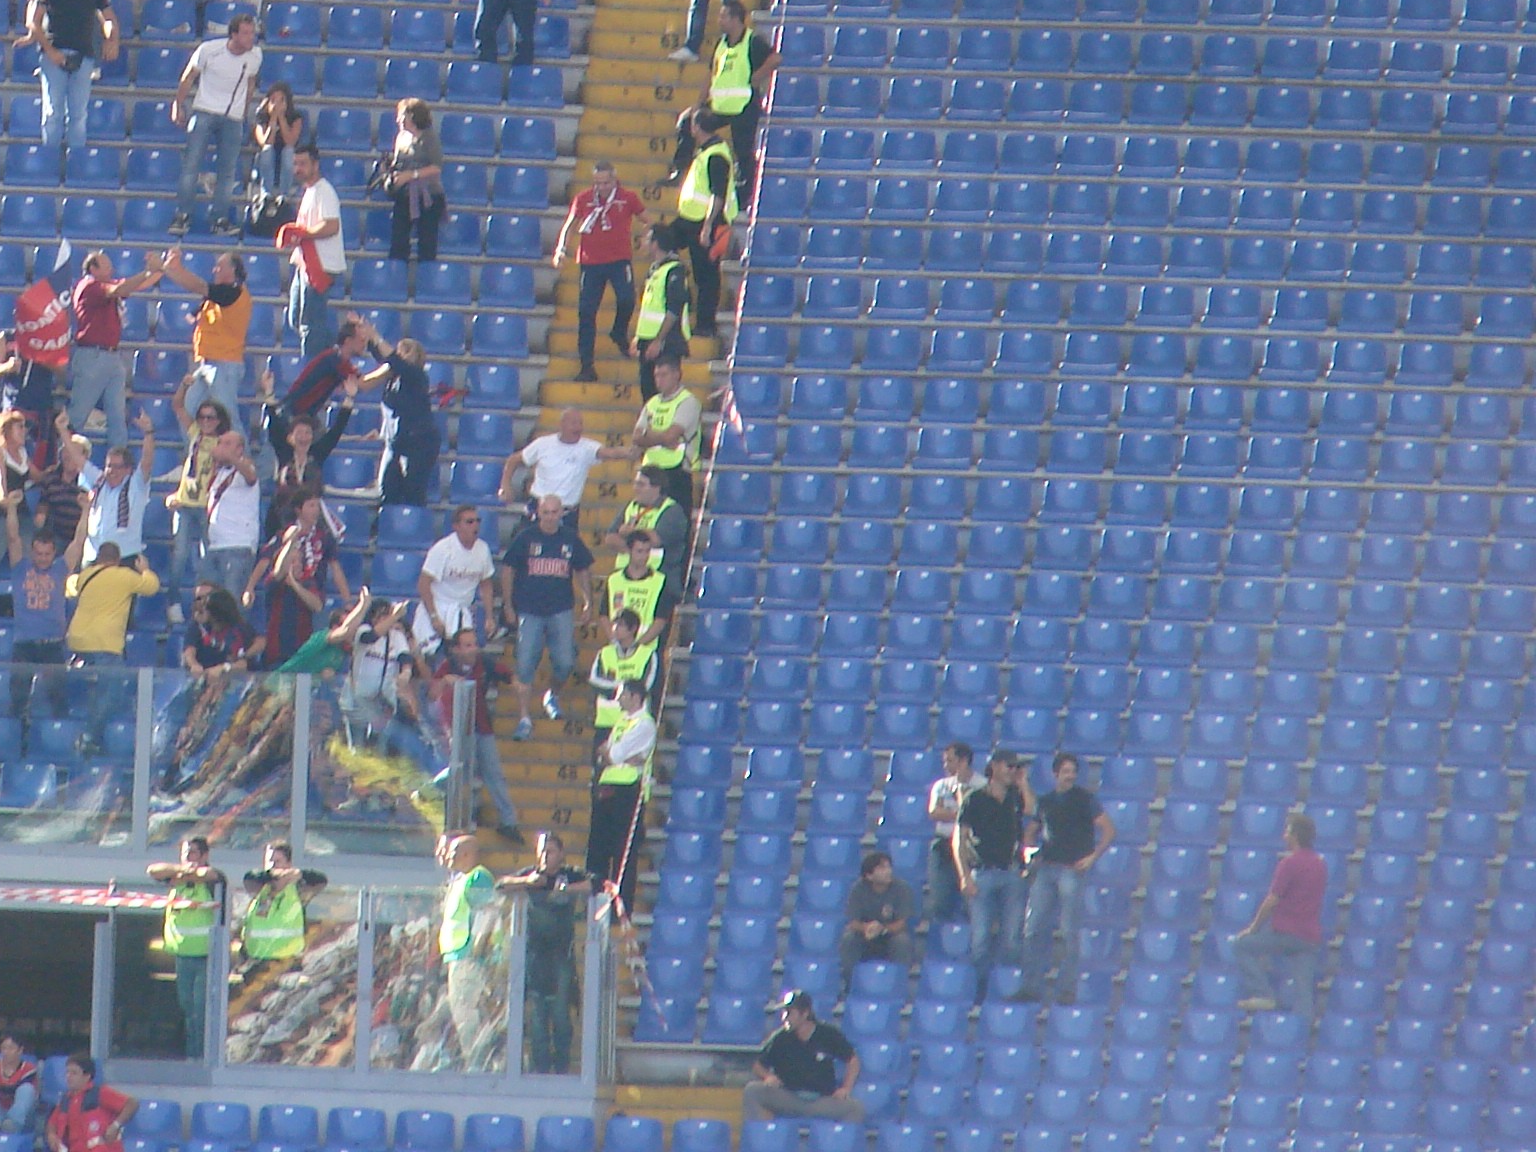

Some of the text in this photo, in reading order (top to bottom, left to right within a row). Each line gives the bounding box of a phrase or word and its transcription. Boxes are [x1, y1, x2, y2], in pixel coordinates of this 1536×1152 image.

[654, 85, 674, 101] 62
[649, 137, 667, 152] 61
[643, 185, 662, 201] 60
[552, 808, 571, 824] 47
